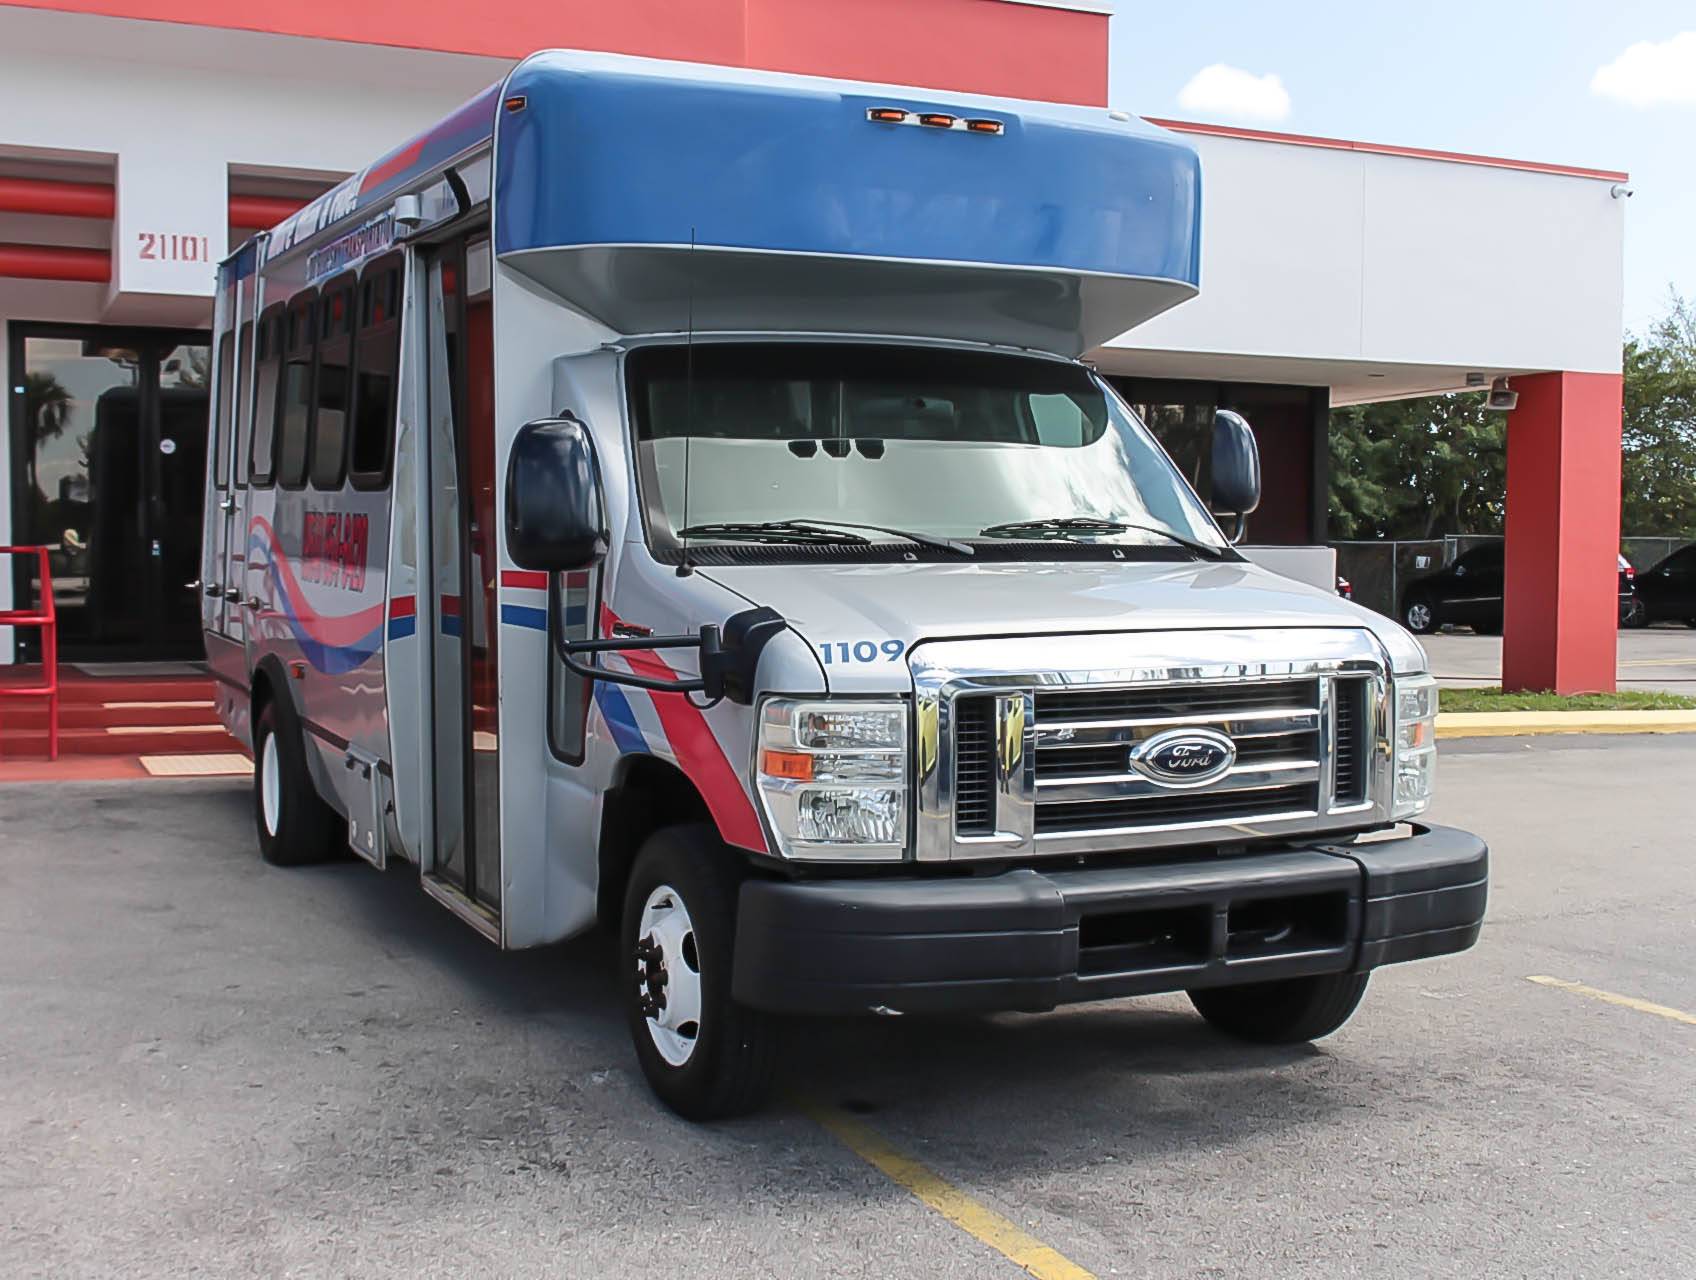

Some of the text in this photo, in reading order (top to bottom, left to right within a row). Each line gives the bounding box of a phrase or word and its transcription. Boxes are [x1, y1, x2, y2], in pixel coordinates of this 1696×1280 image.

[139, 233, 208, 262] 21101
[819, 640, 905, 664] 1109
[1168, 745, 1213, 768] Ford
